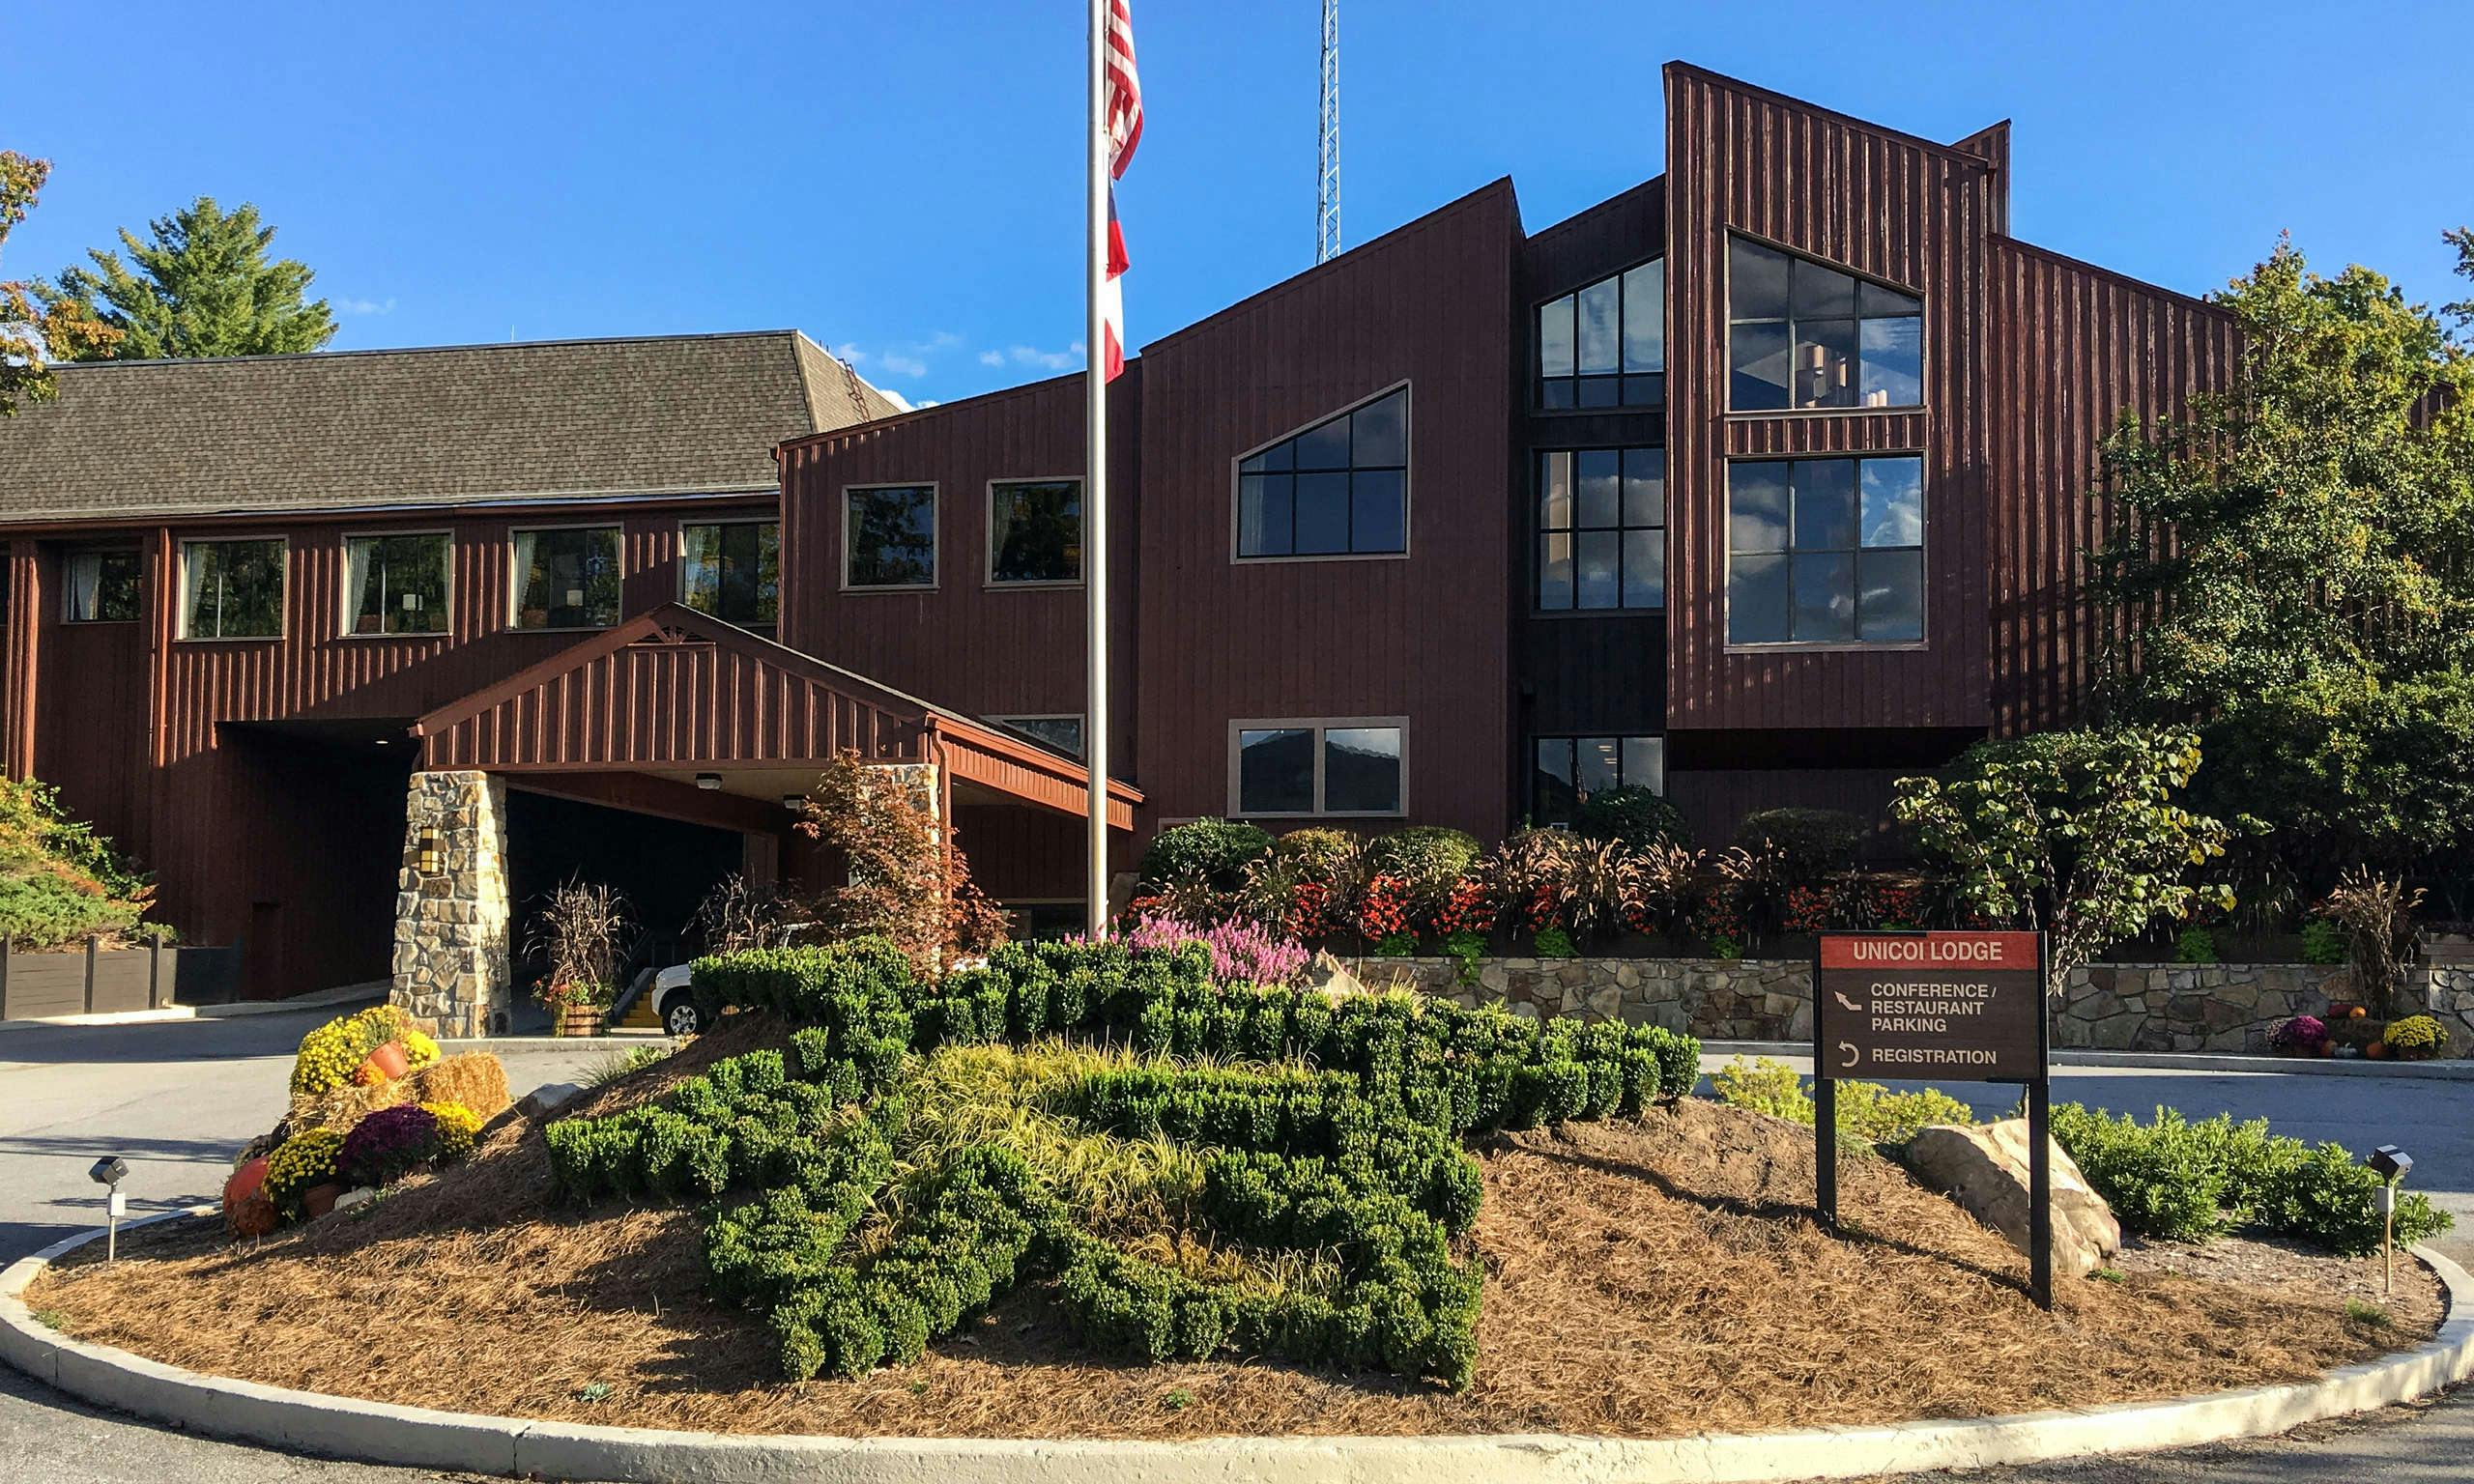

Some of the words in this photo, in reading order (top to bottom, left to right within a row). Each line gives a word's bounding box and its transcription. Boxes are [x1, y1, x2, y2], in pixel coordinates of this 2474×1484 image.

[1853, 941, 1924, 961] UNICOI
[1931, 941, 2003, 961] LODGE
[1871, 1000, 1985, 1015] RESTAURANT
[1871, 1017, 1947, 1033] PARKING
[1872, 1048, 1997, 1065] REGISTRATION
